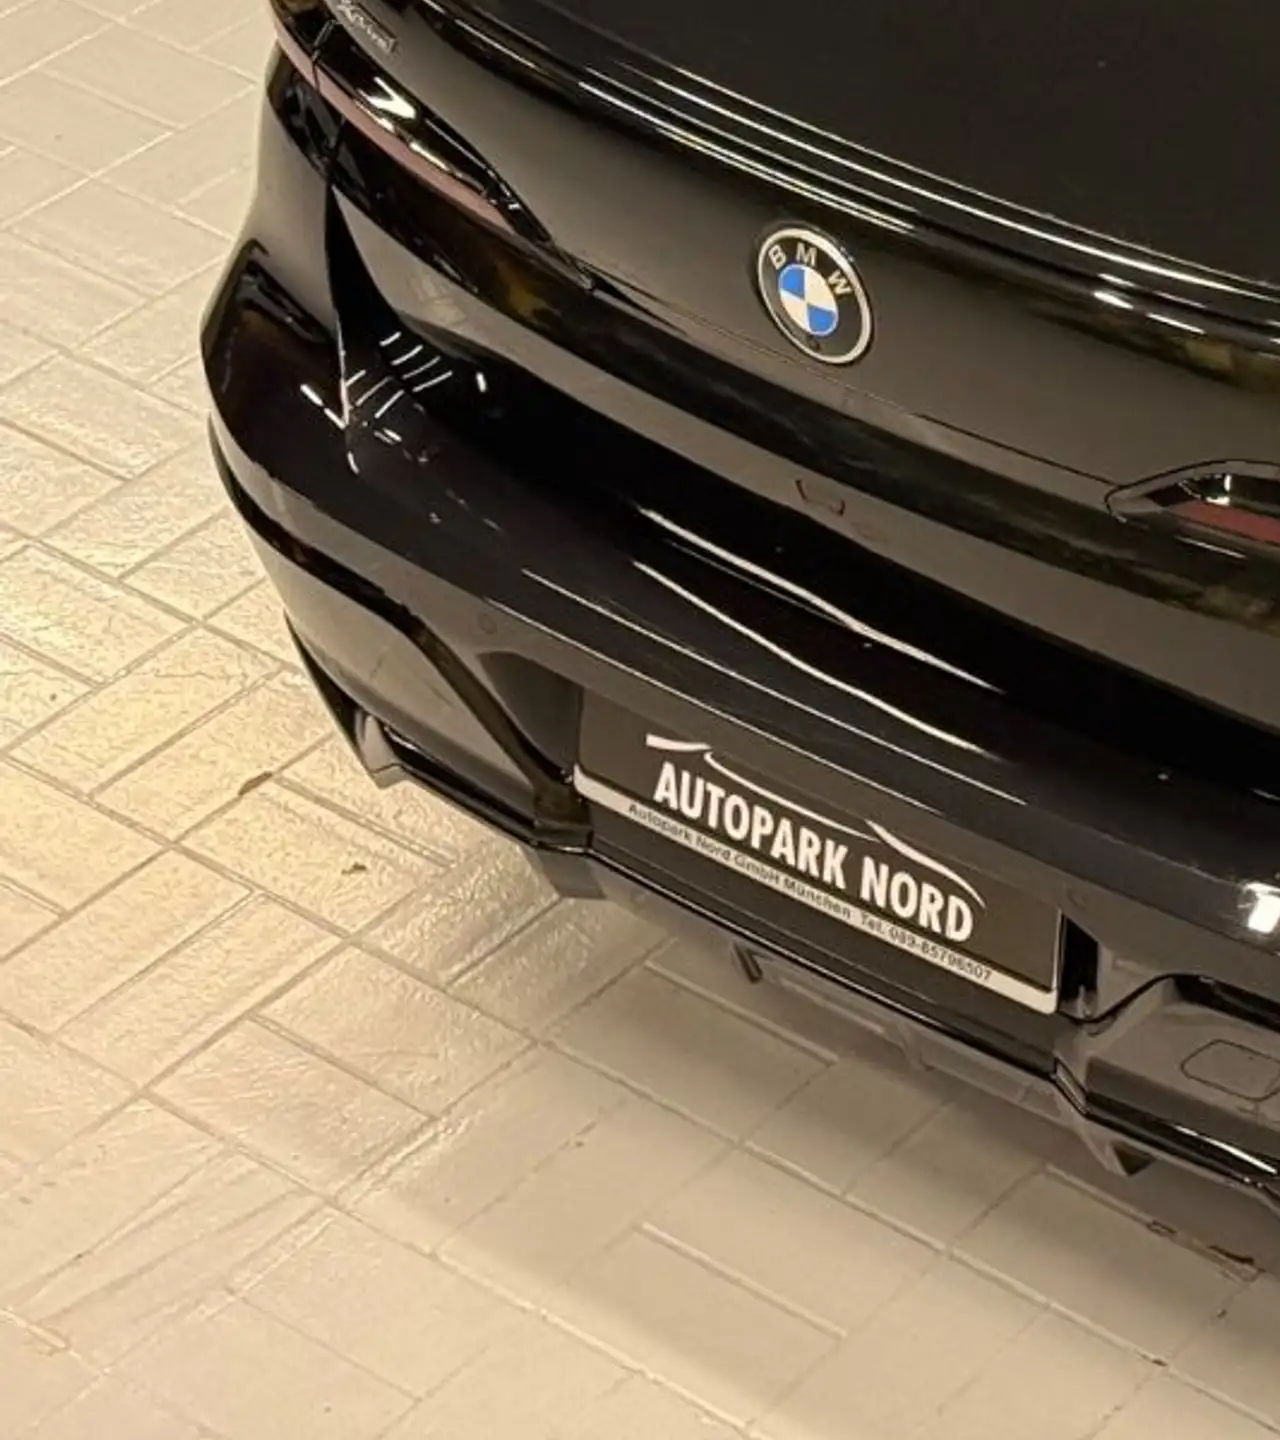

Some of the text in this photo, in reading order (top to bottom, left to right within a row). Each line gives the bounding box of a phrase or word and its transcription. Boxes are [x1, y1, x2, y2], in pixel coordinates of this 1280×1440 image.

[768, 242, 852, 296] BMW
[628, 803, 694, 846] Autopark
[695, 834, 732, 861] Nord
[653, 761, 974, 943] AUTOPARK NORD
